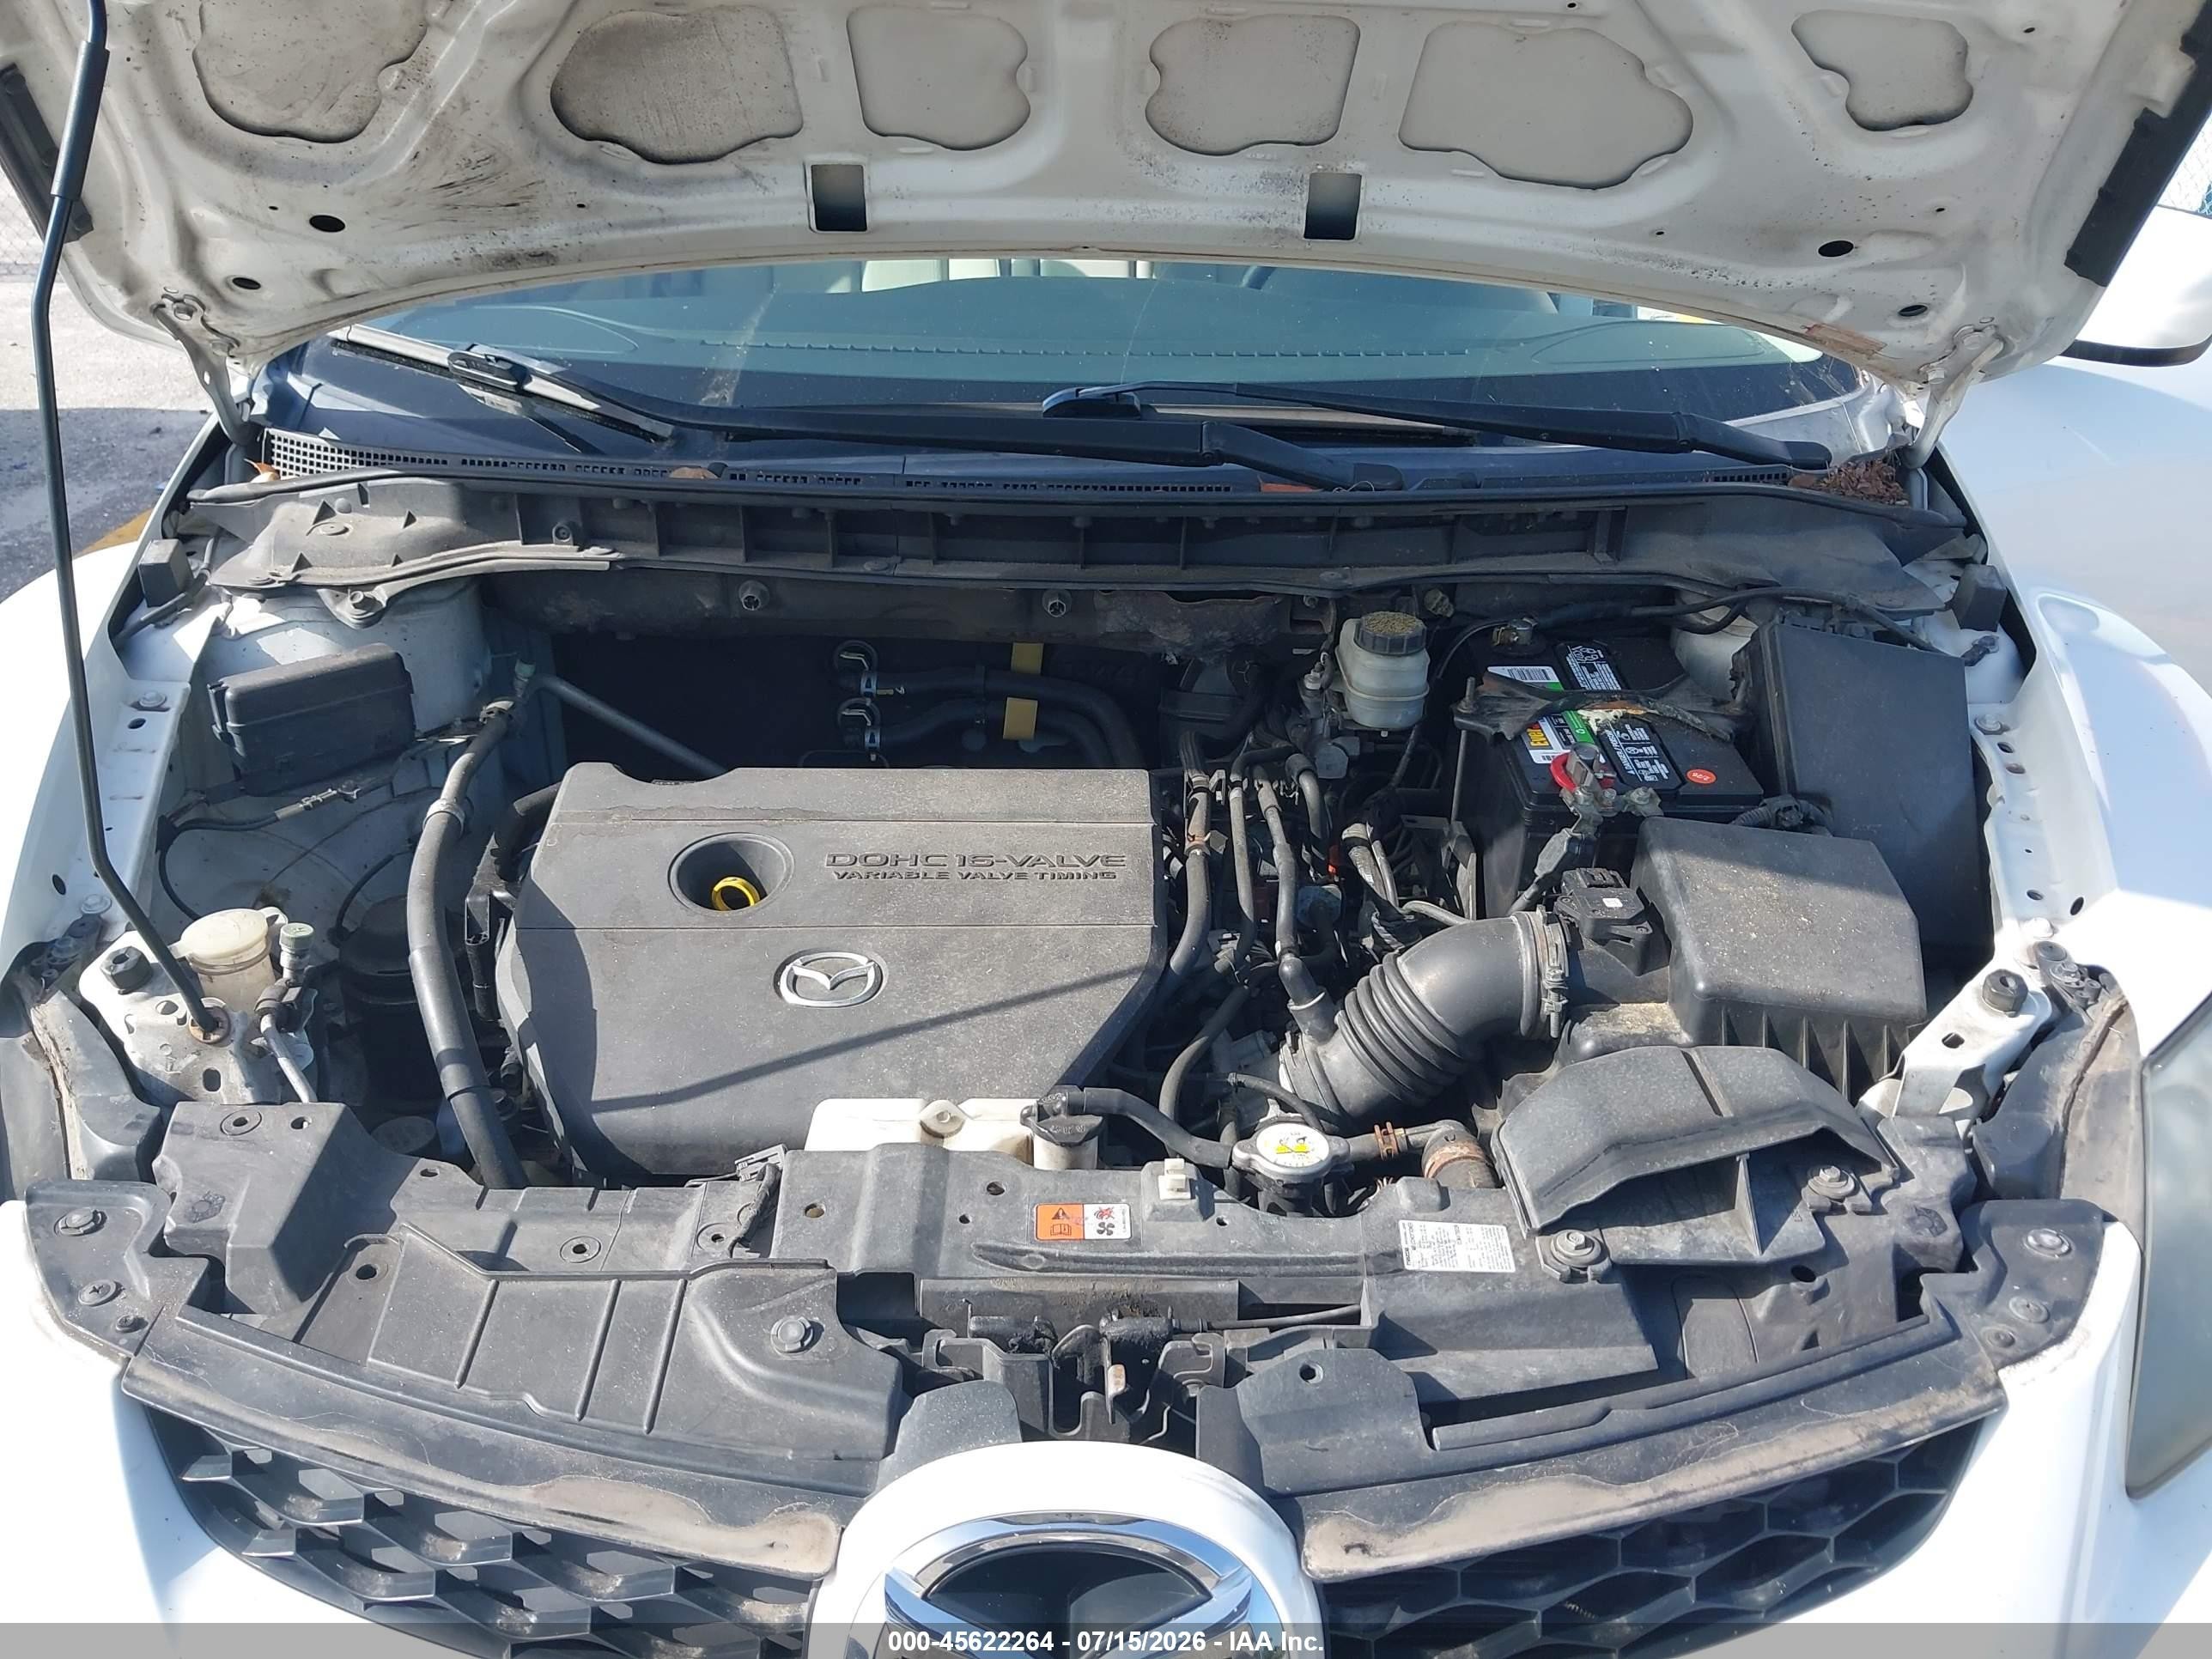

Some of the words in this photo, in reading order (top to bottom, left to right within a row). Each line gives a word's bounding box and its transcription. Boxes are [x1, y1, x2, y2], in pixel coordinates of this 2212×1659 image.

[825, 853, 948, 867] DOHC
[955, 854, 1127, 868] 16-VALVE
[834, 871, 951, 880] VARIABLE
[957, 871, 1030, 880] VALVE
[1033, 871, 1117, 880] TIMING
